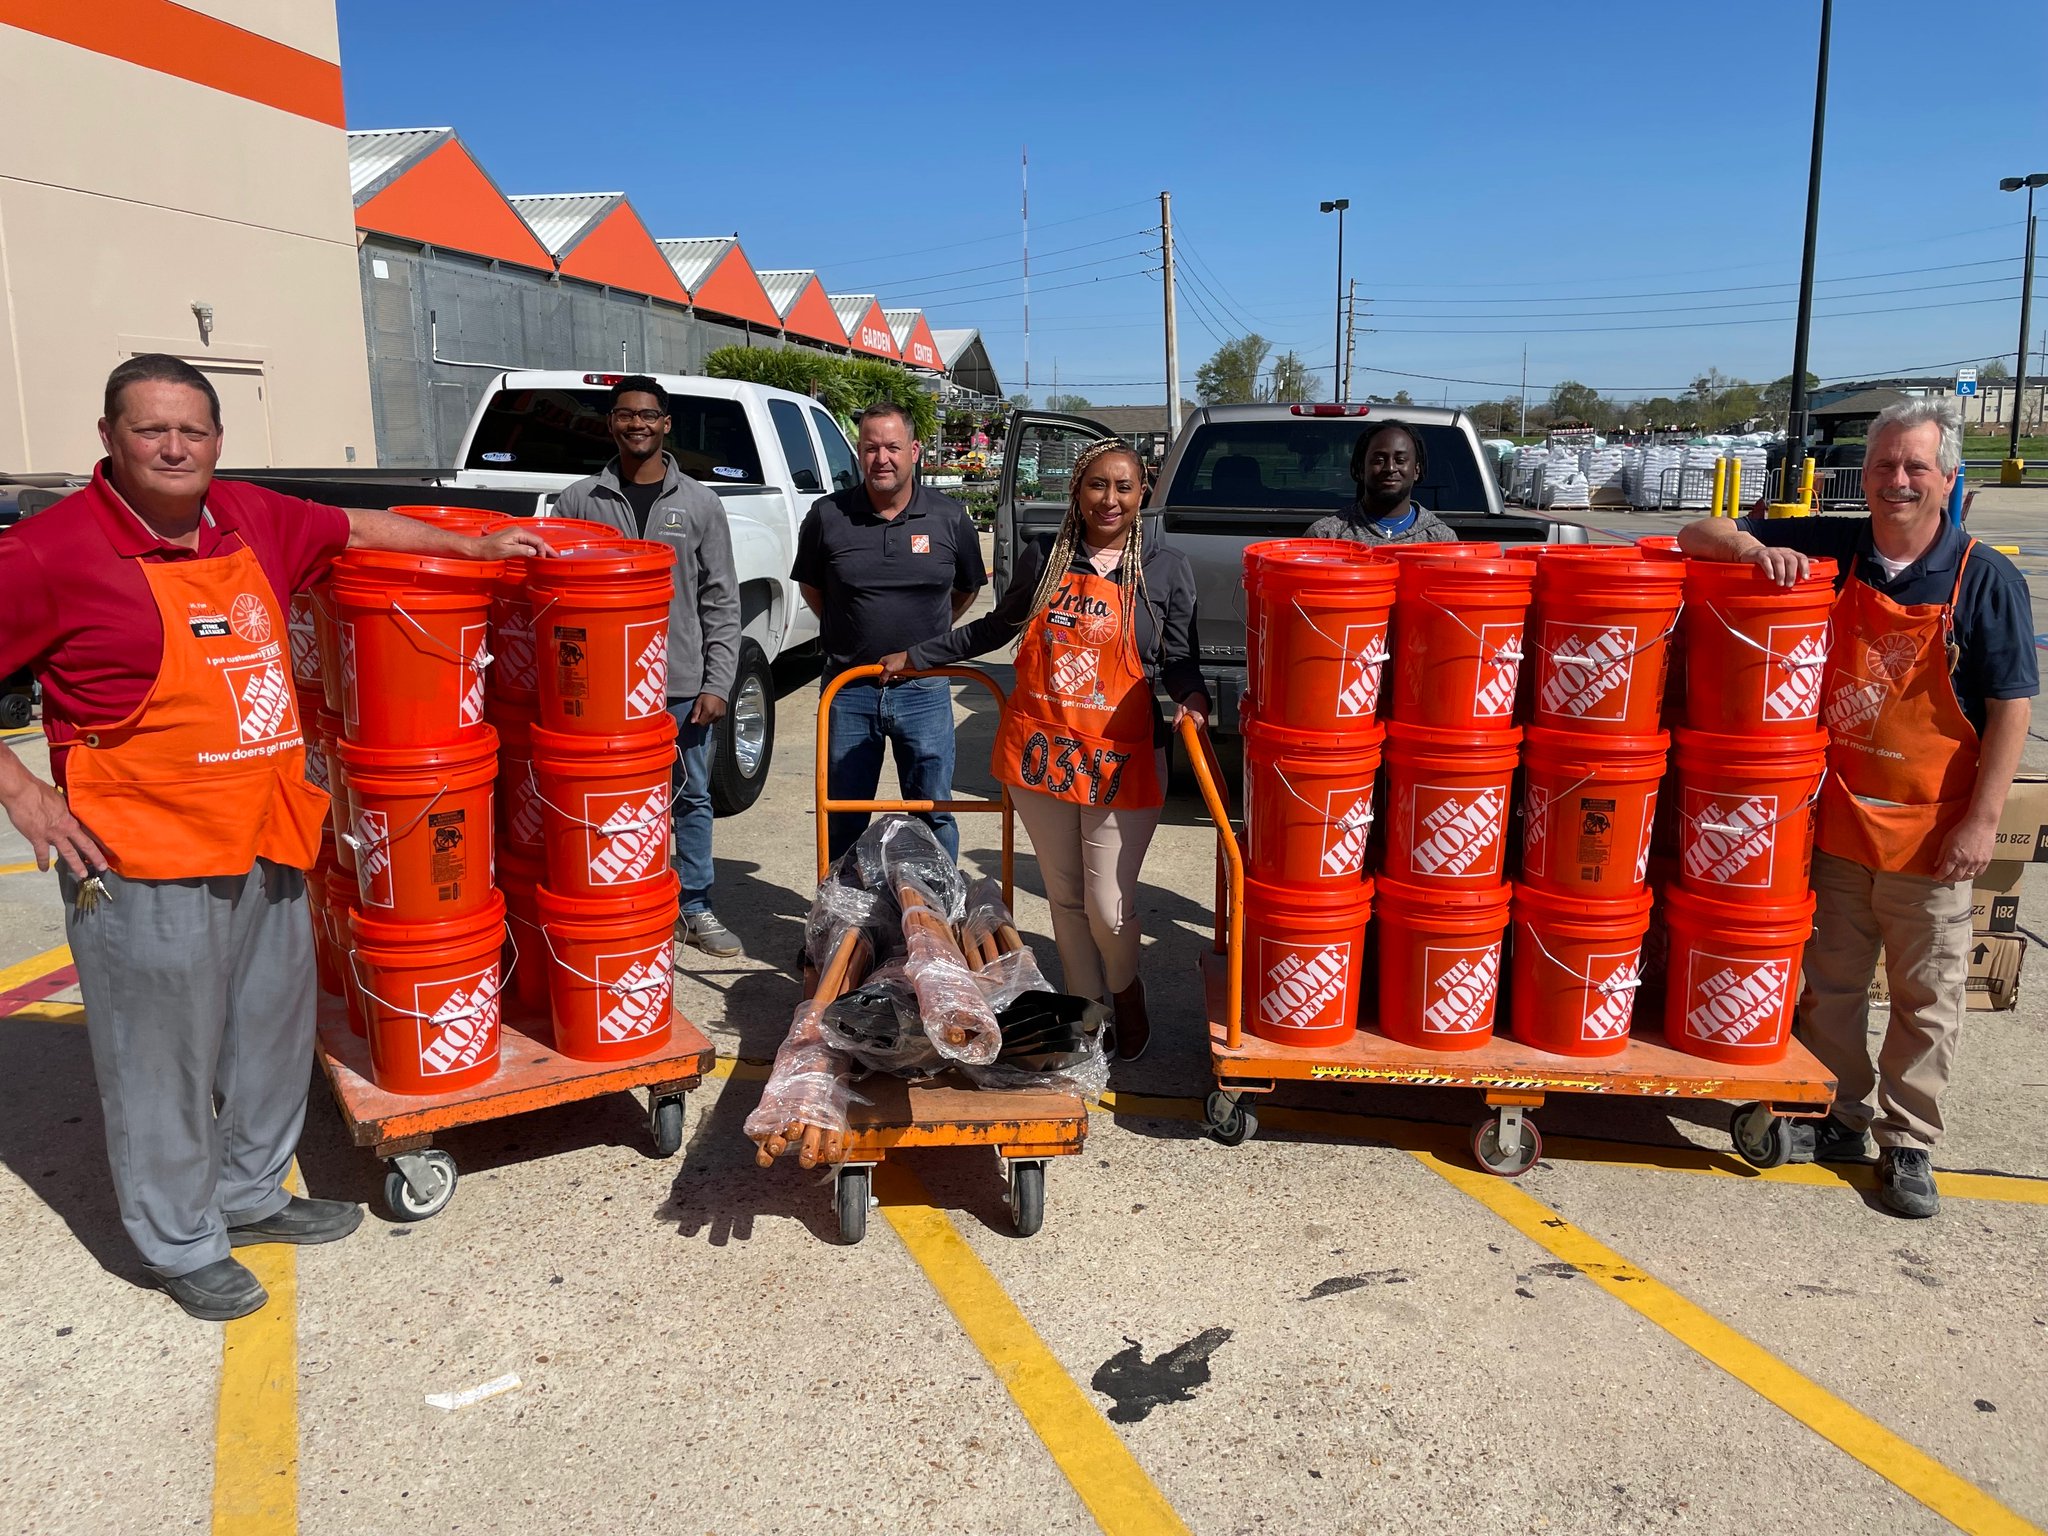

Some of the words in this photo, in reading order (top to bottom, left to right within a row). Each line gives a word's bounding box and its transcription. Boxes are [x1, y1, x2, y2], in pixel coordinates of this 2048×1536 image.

[862, 326, 891, 353] GARDEN
[914, 342, 933, 364] CENTER
[212, 657, 225, 666] put
[226, 652, 262, 663] customers
[635, 631, 664, 670] THE
[1049, 648, 1099, 692] HOME
[1054, 650, 1075, 668] THE
[1542, 627, 1634, 713] HOME
[241, 662, 284, 740] HOME
[242, 673, 262, 705] THE
[1065, 667, 1097, 695] DEPOT
[1568, 662, 1630, 716] DEPOT
[1833, 682, 1857, 700] THE
[266, 687, 290, 737] DEPOT
[1062, 700, 1075, 708] get
[1076, 702, 1097, 710] more
[1823, 682, 1885, 726] HOME
[1838, 705, 1880, 733] DEPOT
[198, 752, 230, 763] How
[231, 747, 265, 760] doers
[267, 743, 279, 756] get
[279, 737, 304, 750] more
[1020, 731, 1131, 806] 0347
[1834, 736, 1848, 747] get
[1850, 740, 1874, 754] more
[1876, 748, 1906, 760] done.
[590, 787, 667, 883] HOME
[1413, 788, 1503, 873] HOME
[1421, 797, 1463, 832] THE
[625, 815, 667, 880] DEPOT
[1446, 820, 1500, 876] DEPOT
[1685, 797, 1776, 878] HOME
[1711, 830, 1773, 882] DEPOT
[2010, 833, 2031, 844] 228
[1972, 905, 1986, 915] 22
[1996, 905, 2015, 918] 281
[1261, 945, 1349, 1024] HOME
[1267, 952, 1305, 984] THE
[1425, 946, 1499, 1031] HOME
[1434, 958, 1473, 992] THE
[1697, 967, 1741, 999] THE
[434, 988, 469, 1028] HE
[600, 942, 673, 1040] HOME
[1290, 975, 1346, 1027] DEPOT
[1687, 961, 1787, 1039] HOME
[421, 969, 498, 1072] HOME
[460, 998, 498, 1066] DEPOT
[1721, 991, 1783, 1044] DEPOT
